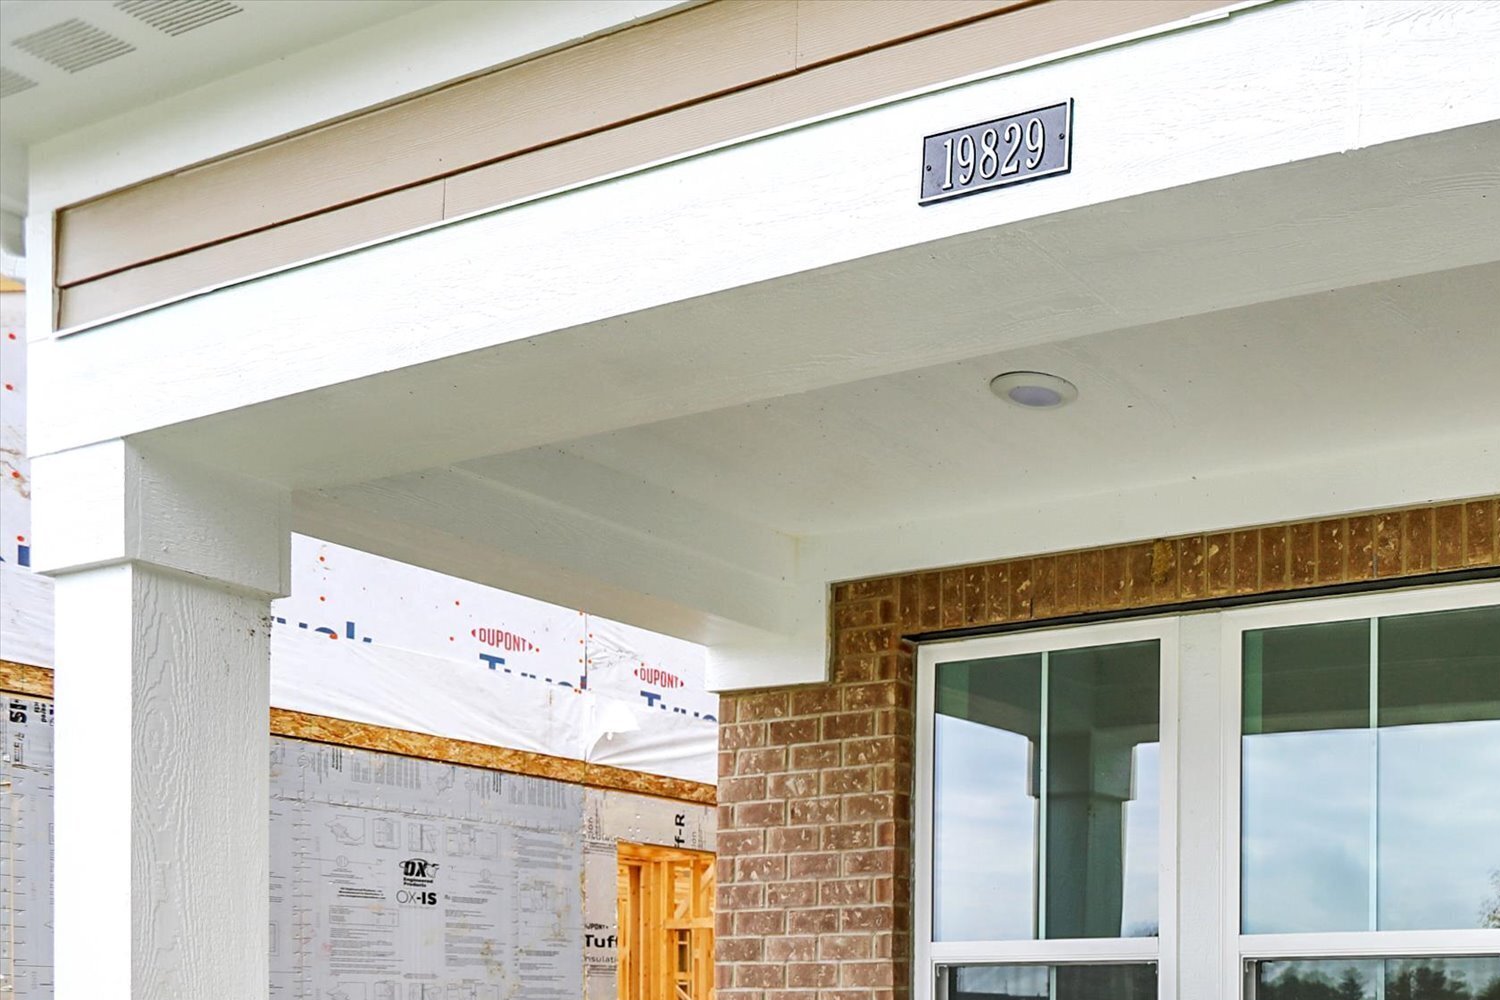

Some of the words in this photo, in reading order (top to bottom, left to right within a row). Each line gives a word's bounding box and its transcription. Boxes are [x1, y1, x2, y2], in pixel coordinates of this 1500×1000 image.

[942, 117, 1046, 191] 19829
[478, 626, 527, 653] DUPONT
[639, 666, 680, 689] DUPONT
[403, 860, 428, 878] OX
[396, 889, 438, 906] OX-IS
